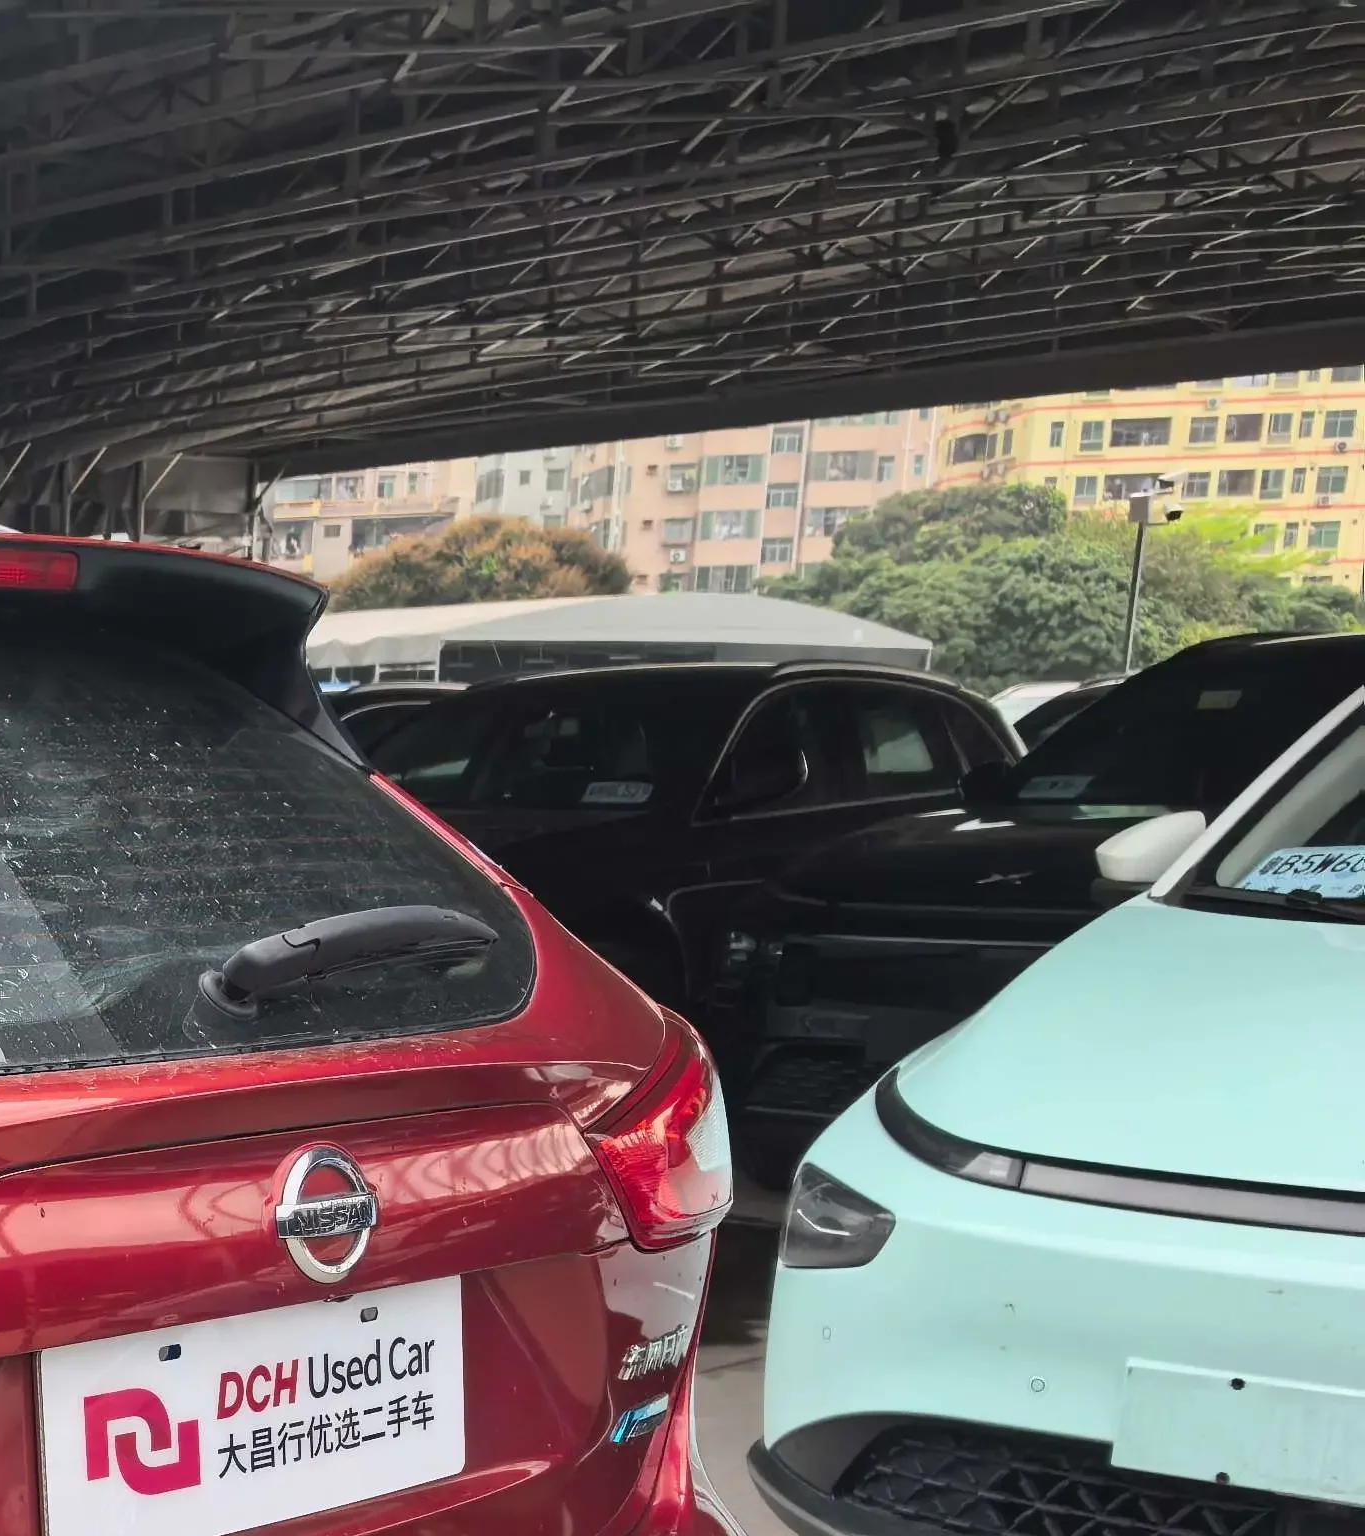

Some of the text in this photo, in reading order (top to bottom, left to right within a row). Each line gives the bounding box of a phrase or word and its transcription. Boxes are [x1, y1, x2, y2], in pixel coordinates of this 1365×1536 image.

[291, 1197, 373, 1234] NISSAN
[216, 1336, 435, 1420] DCH Used Car
[217, 1390, 435, 1479] 大昌行优选二手车
